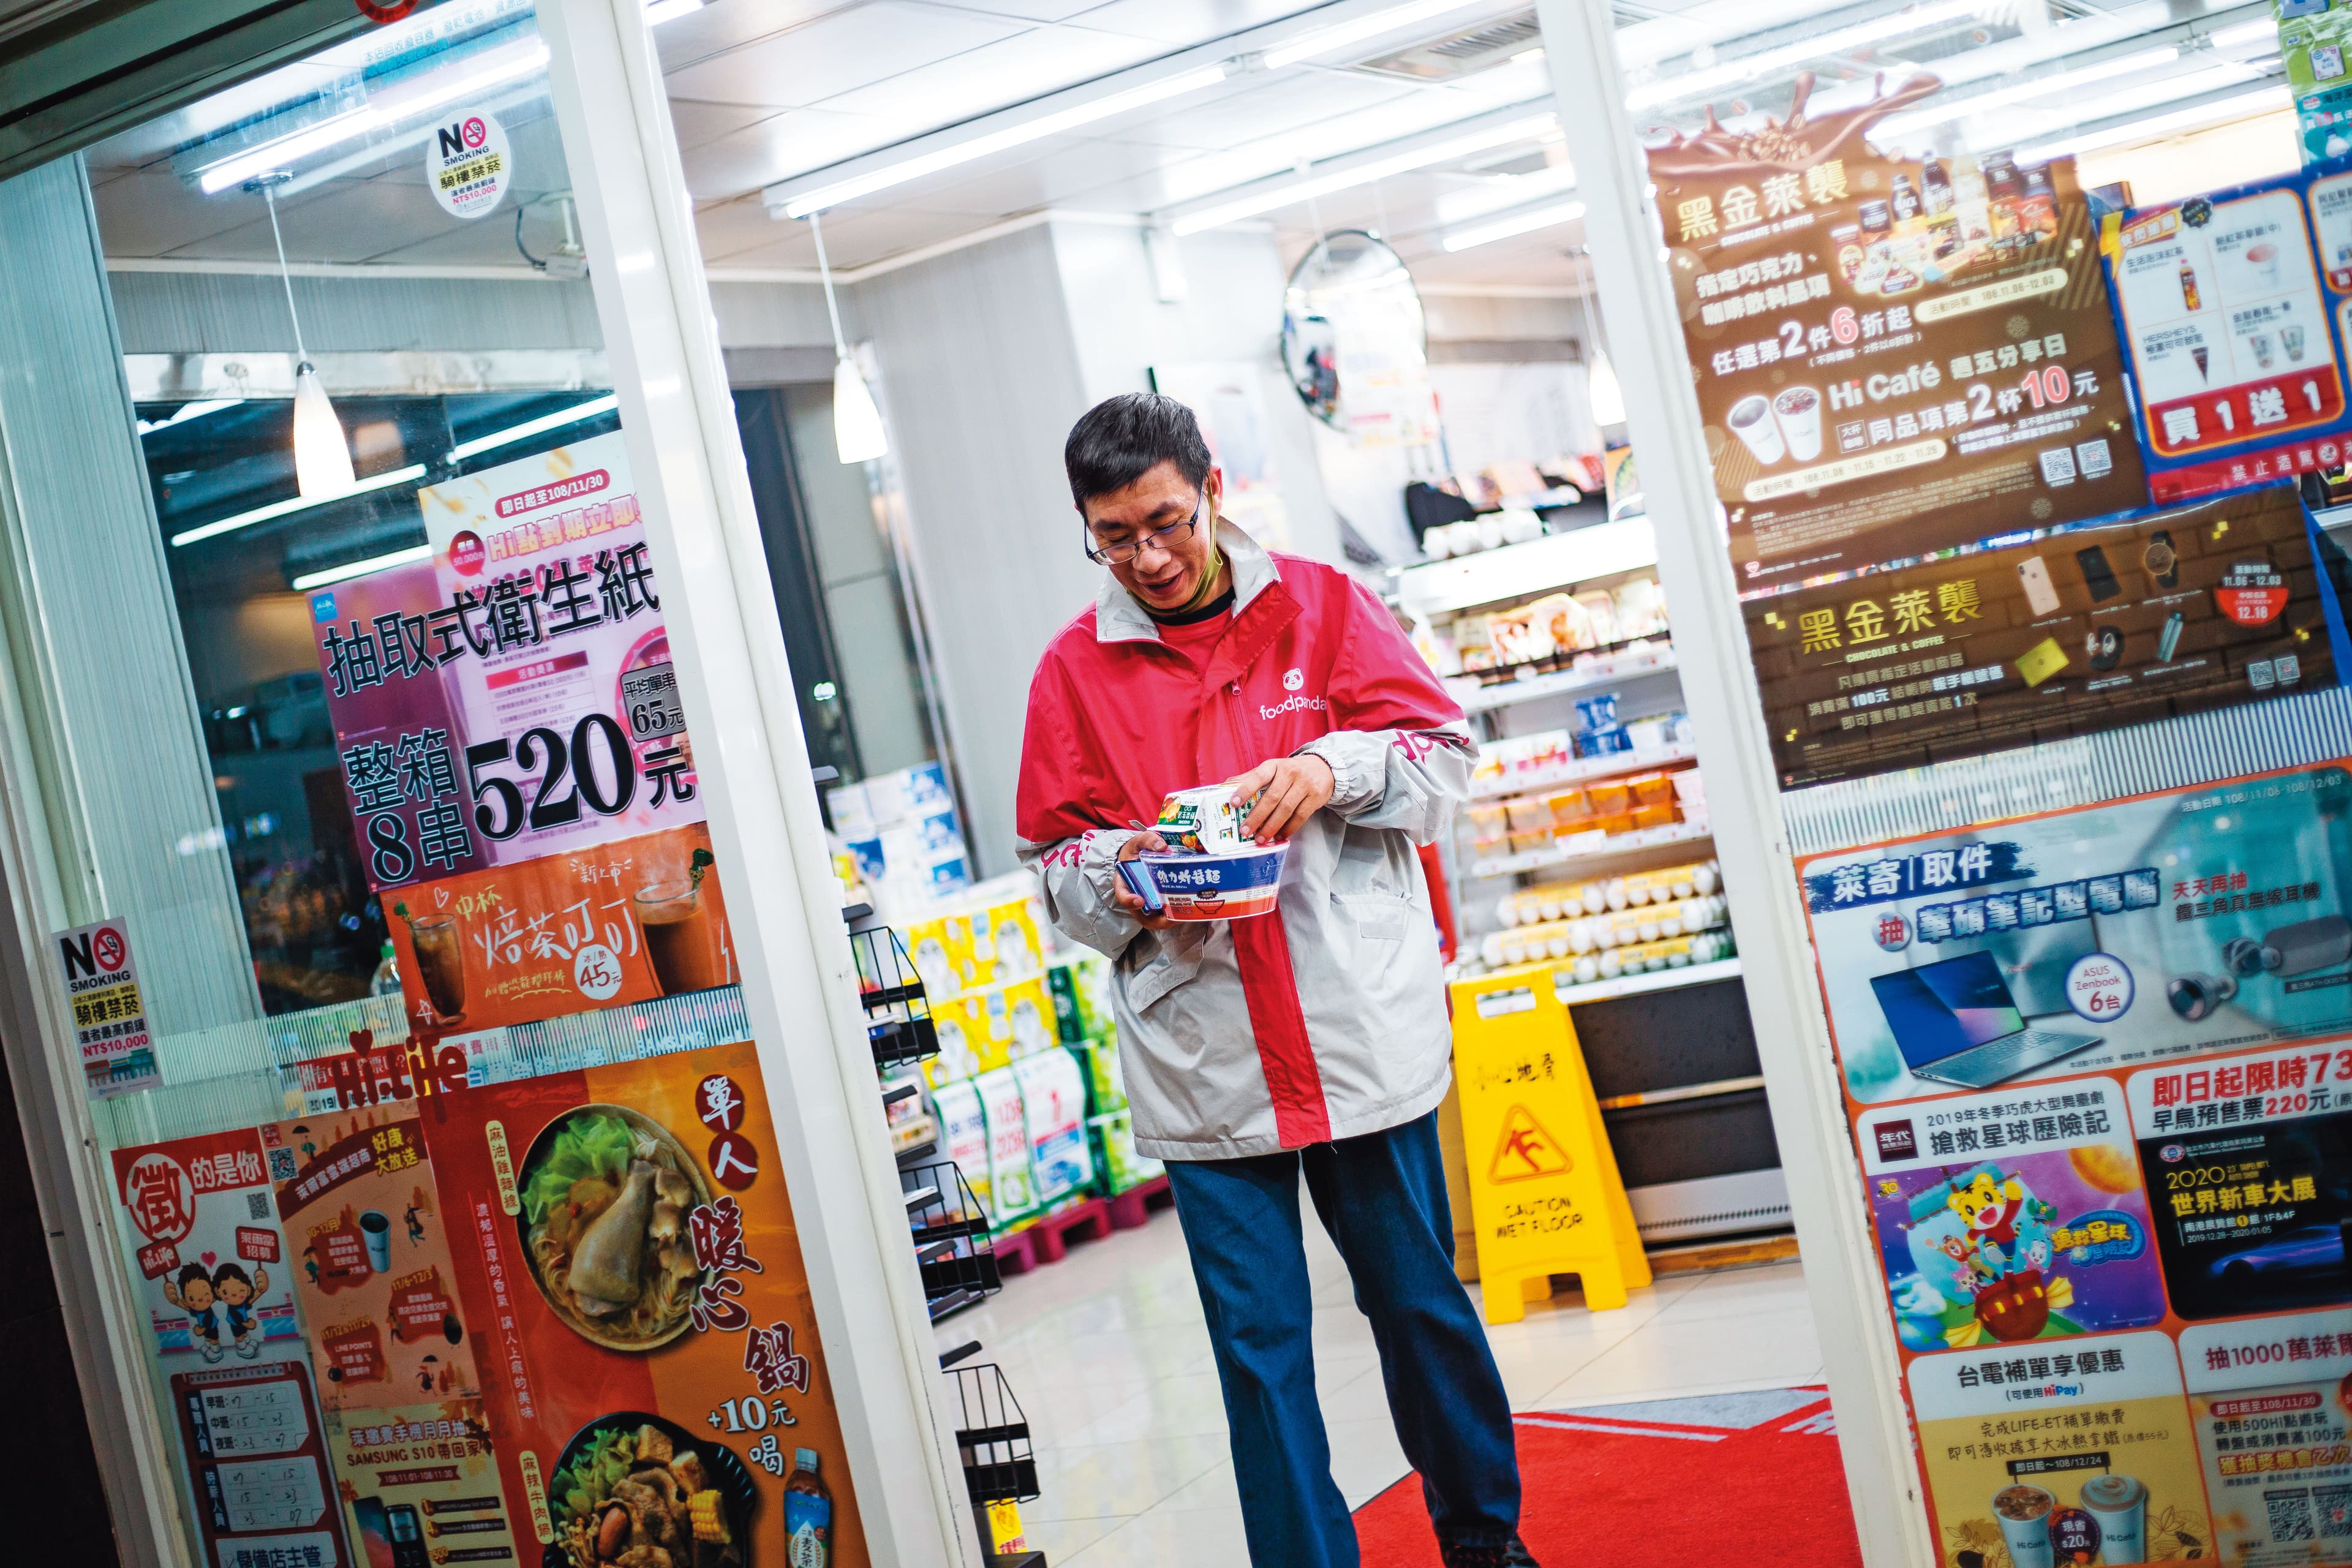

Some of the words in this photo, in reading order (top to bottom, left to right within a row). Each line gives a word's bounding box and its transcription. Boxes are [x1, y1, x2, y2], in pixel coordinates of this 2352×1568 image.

[443, 146, 489, 167] SMOKING
[440, 159, 501, 190] 騎樓禁菸
[453, 184, 497, 205] NT$10,000
[1677, 159, 1850, 241] 黑金萊襲
[1866, 361, 1942, 401] Café
[500, 474, 604, 515] 即日起至108/11/30
[322, 541, 661, 698] 抽取式衛生紙
[1798, 578, 1985, 655] 黑金萊襲
[1845, 644, 1898, 663] CHOCOLATE
[1912, 635, 1945, 650] COFFEE
[624, 671, 677, 699] 平均單串
[631, 698, 686, 735] 65元
[1259, 694, 1327, 721] foodpanda
[341, 728, 458, 817] 整箱
[466, 712, 696, 841] 520元
[366, 800, 473, 883] 8串
[578, 861, 624, 886] 新上市
[2173, 870, 2248, 900] 天天再抽
[454, 884, 502, 922] 中杯
[1879, 918, 1905, 946] 抽
[70, 970, 131, 993] SMOKING
[2075, 974, 2122, 992] Zenbook
[2083, 965, 2111, 979] ASUS
[75, 993, 140, 1027] 騎樓禁菸
[2089, 990, 2121, 1013] 6台
[82, 1033, 149, 1058] NT$10,000
[371, 1127, 404, 1155] 好康
[703, 1075, 759, 1180] 單人
[1880, 1128, 1911, 1143] 年代
[1929, 1109, 2111, 1156] 搶救星球歷險記
[374, 1146, 421, 1177] 大放送
[2166, 1166, 2226, 1190] 2020
[130, 1159, 192, 1238] 徵
[190, 1151, 262, 1189] 的是你
[2169, 1176, 2318, 1218] 世界新車大展
[689, 1194, 810, 1395] 暖心鍋
[1957, 1348, 2125, 1389] 台電補單享優惠
[707, 1395, 796, 1433] +10元
[346, 1448, 409, 1467] SAMSUNG
[412, 1446, 435, 1460] S10
[437, 1440, 481, 1461] 帶回家
[748, 1434, 785, 1476] 喝
[2062, 1520, 2086, 1532] 現省
